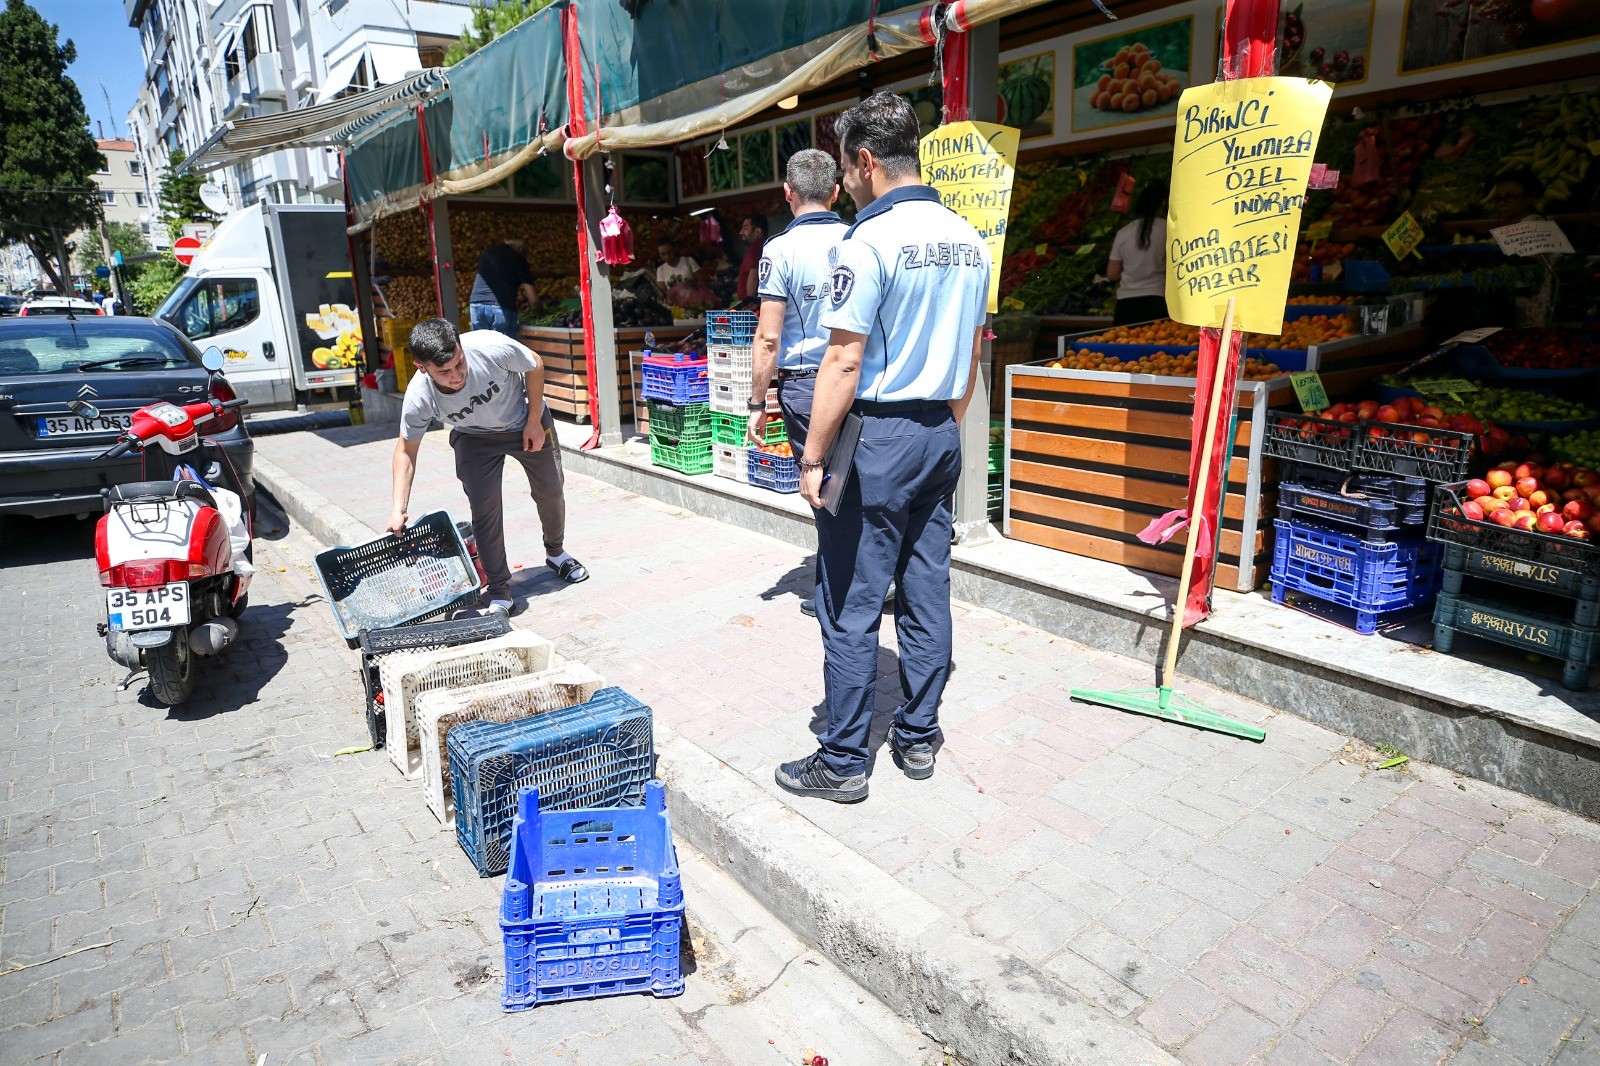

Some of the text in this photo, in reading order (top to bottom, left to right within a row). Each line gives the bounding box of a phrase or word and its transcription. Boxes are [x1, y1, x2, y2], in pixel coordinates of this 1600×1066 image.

[923, 131, 1003, 160] MANAV
[1222, 130, 1313, 165] YILIMIZA
[1226, 165, 1297, 190] ÖZEL
[902, 242, 983, 270] ZABITA
[1171, 228, 1220, 263] CUMA
[1188, 264, 1261, 296] PAZAR
[178, 385, 204, 393] C5
[46, 418, 68, 433] 35
[74, 417, 94, 432] AR
[111, 586, 184, 608] 35 APS
[132, 607, 171, 626] 504
[547, 956, 642, 979] HIDIROĞLU
